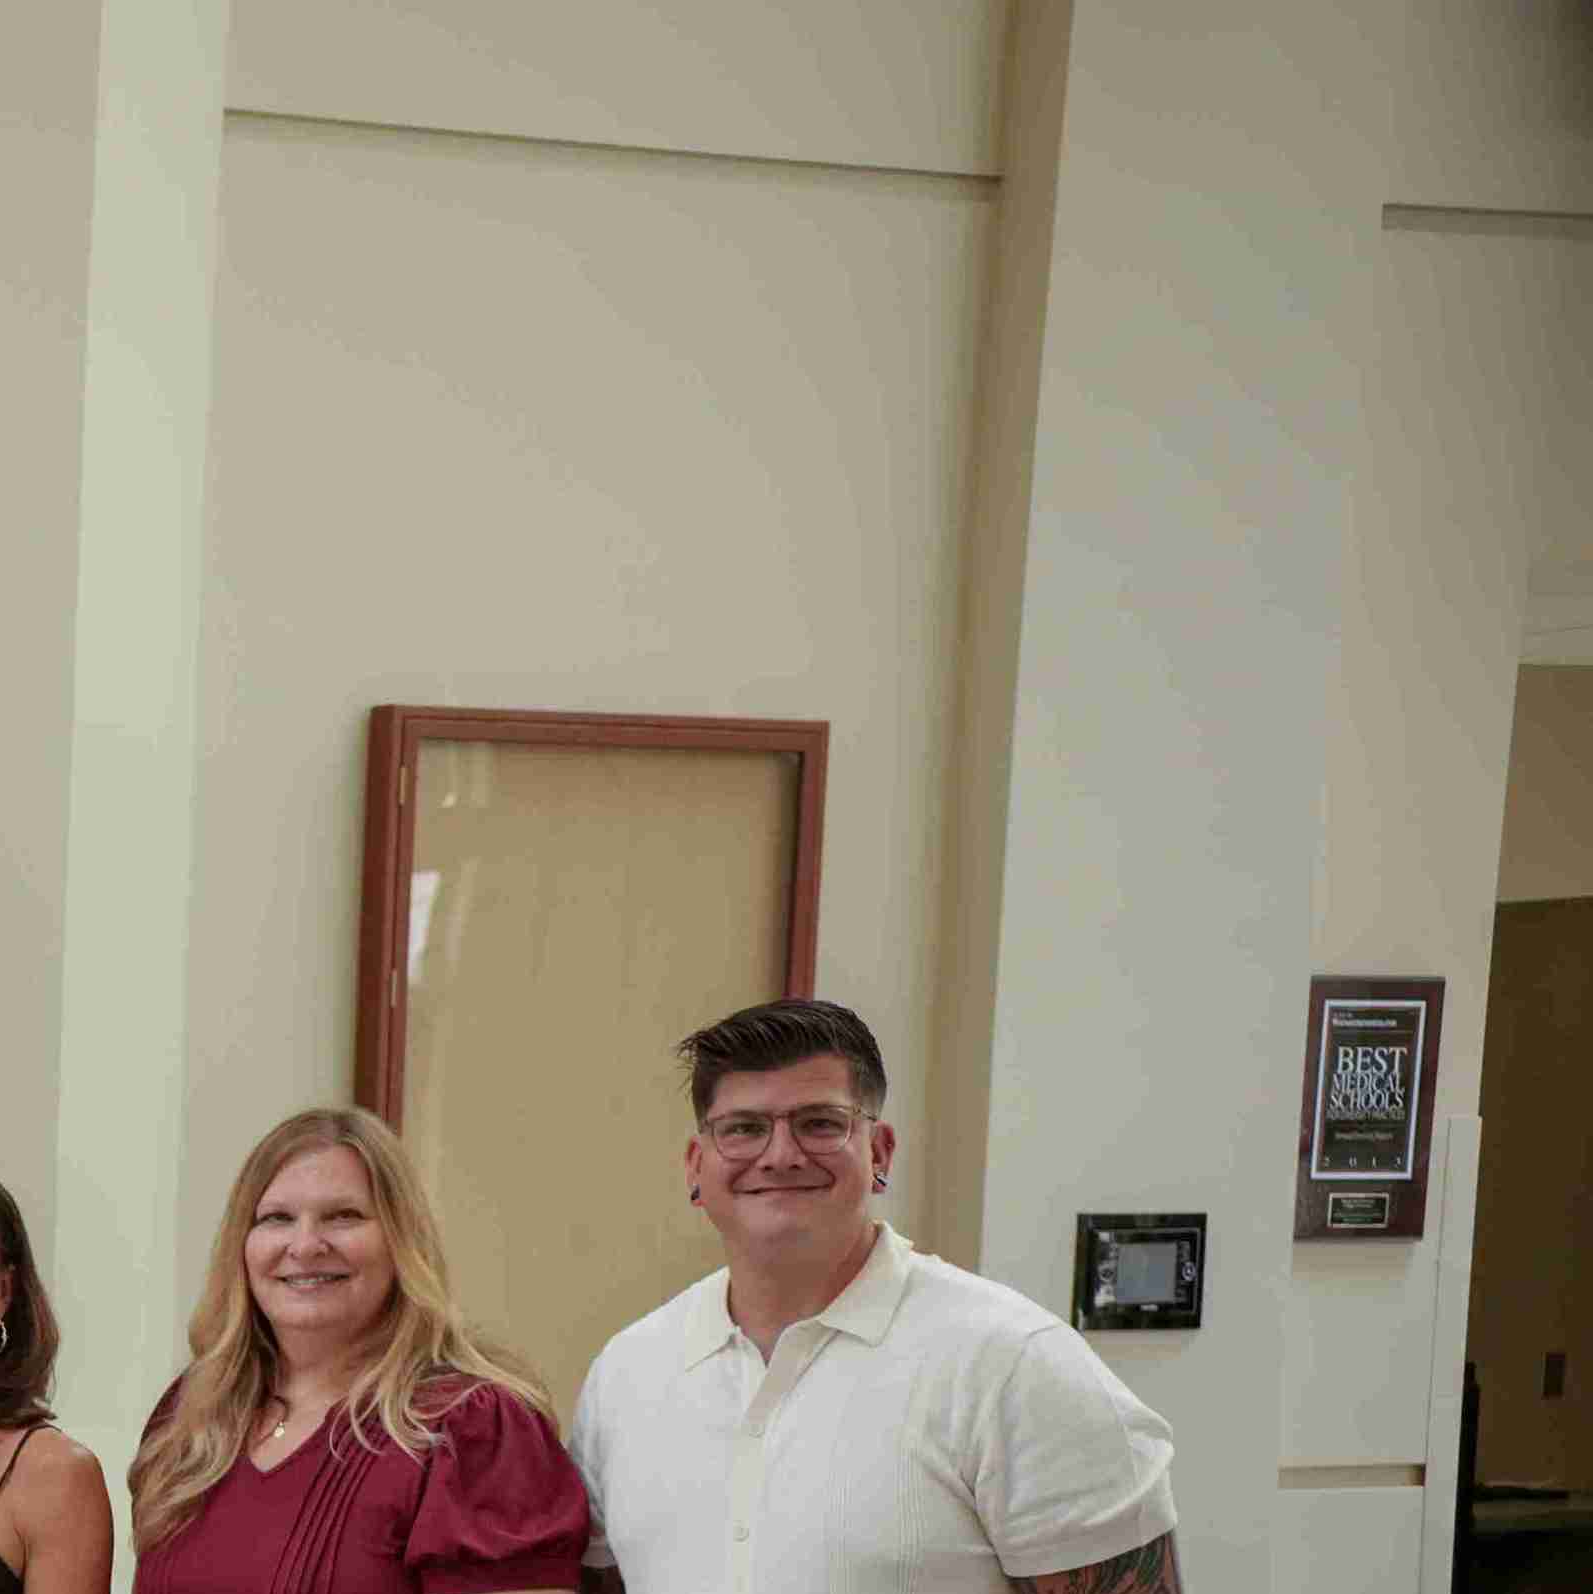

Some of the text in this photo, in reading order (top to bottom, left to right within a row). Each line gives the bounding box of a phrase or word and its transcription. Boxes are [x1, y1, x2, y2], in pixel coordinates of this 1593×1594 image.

[1336, 1046, 1409, 1075] BEST
[1331, 1072, 1404, 1095] MEDICAL
[1328, 1090, 1405, 1111] SCHOOLS
